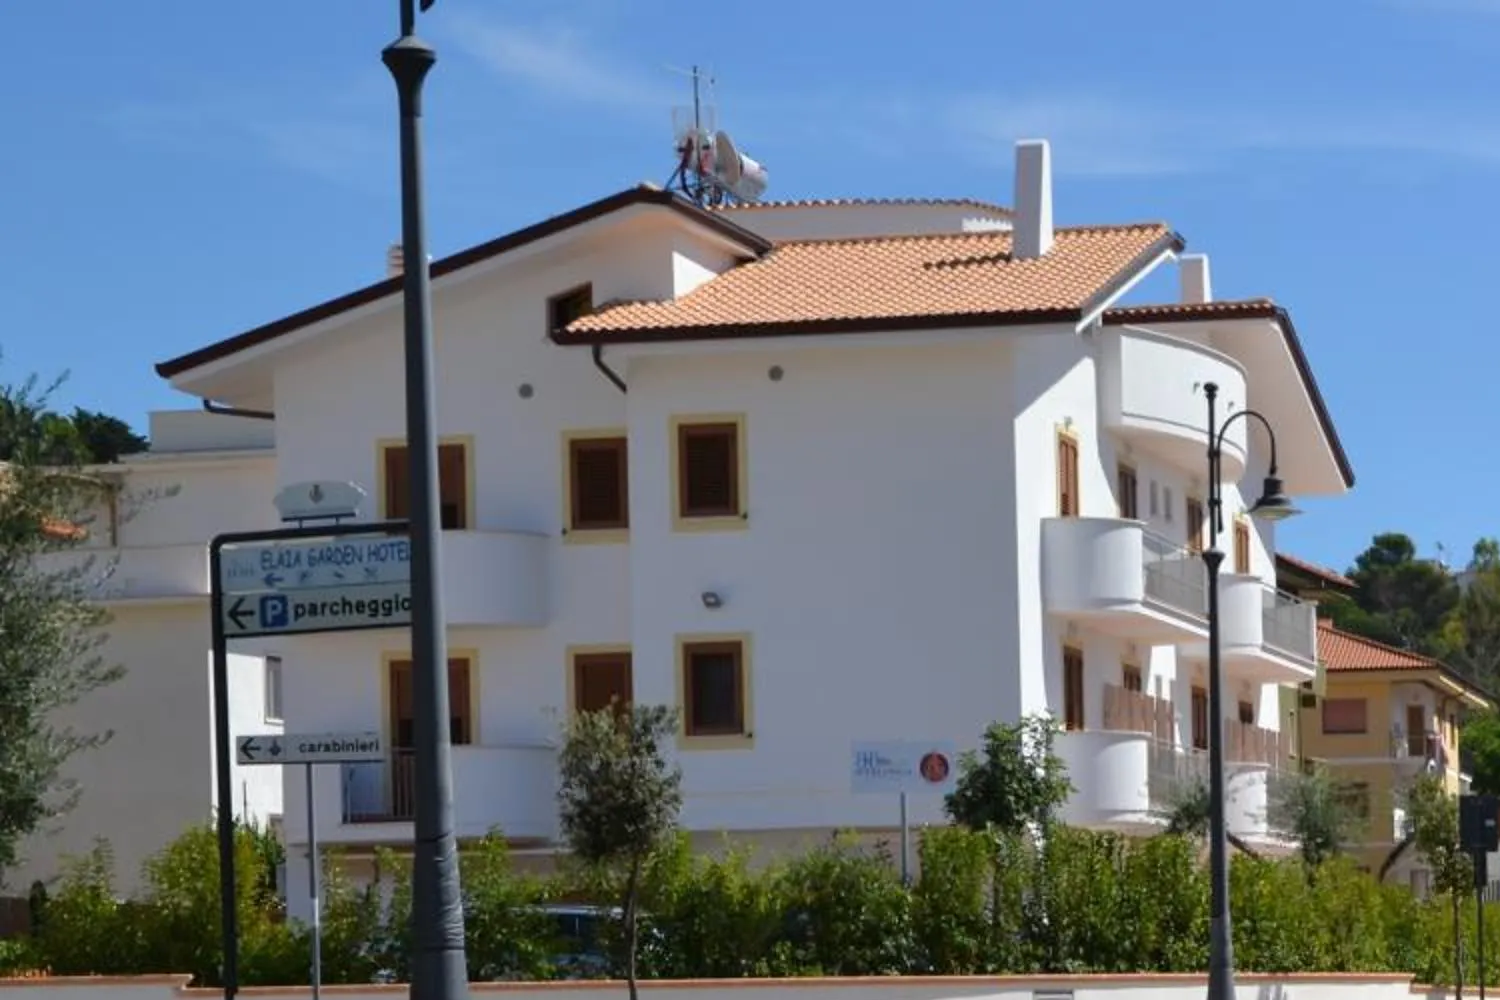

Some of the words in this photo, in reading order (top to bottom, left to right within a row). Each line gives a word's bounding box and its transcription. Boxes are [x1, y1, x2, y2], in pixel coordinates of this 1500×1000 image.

[307, 543, 363, 568] GARDEN
[266, 600, 283, 625] P
[293, 593, 411, 621] parcheggio
[298, 737, 380, 754] carabinieri
